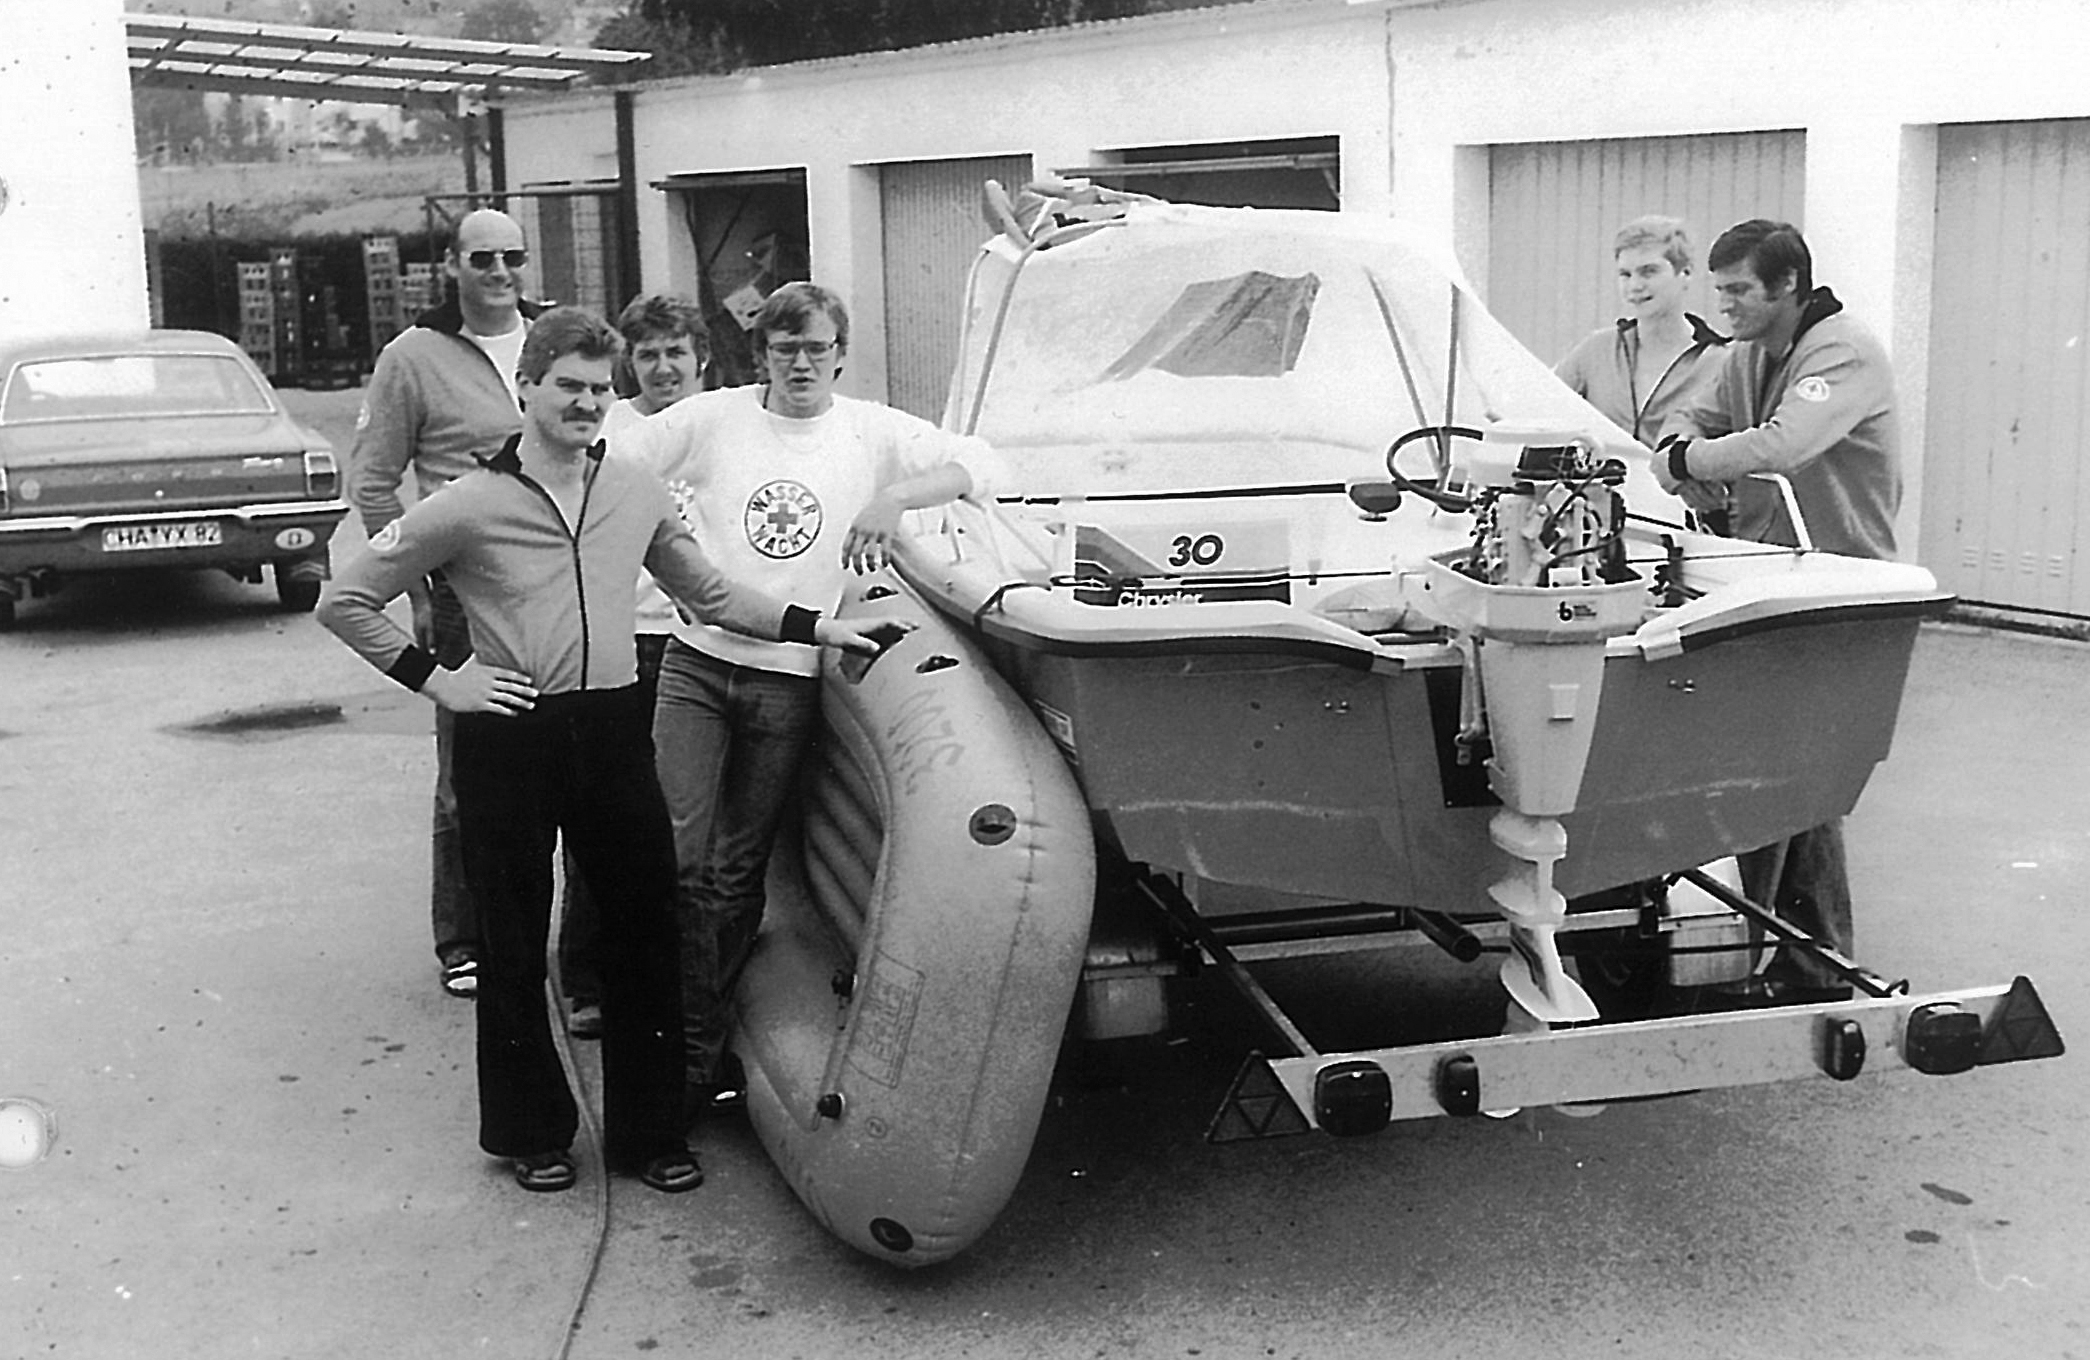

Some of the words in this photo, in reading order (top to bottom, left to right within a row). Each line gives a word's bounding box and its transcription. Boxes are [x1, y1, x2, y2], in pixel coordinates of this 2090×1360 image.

[751, 484, 817, 516] WASSER
[753, 524, 811, 555] WACHT
[1168, 534, 1224, 567] 30
